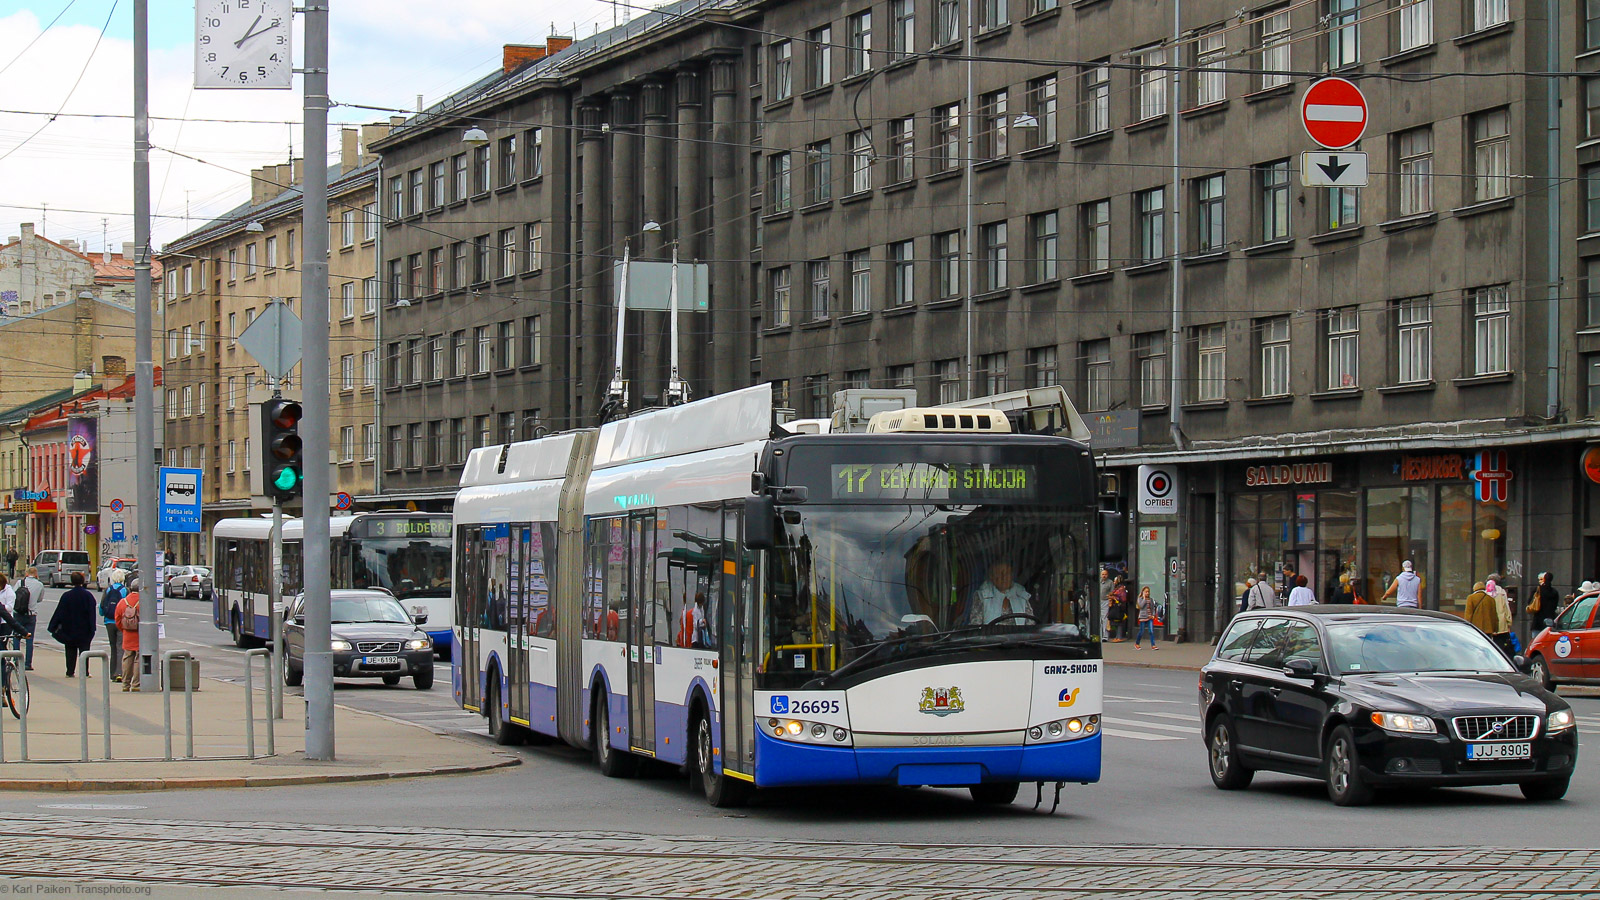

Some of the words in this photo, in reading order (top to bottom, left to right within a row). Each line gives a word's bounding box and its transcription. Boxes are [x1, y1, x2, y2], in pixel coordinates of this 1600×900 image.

[223, 4, 229, 13] 11
[238, 0, 249, 8] 12
[261, 4, 264, 13] 1
[208, 18, 220, 27] 10
[271, 18, 279, 27] 2
[202, 36, 210, 44] 9
[276, 36, 283, 44] 3
[207, 52, 216, 61] 8
[269, 54, 278, 62] 4
[221, 66, 229, 75] 7
[257, 66, 265, 75] 5
[239, 72, 247, 80] 6
[1400, 454, 1463, 481] HESBURGER
[838, 463, 873, 493] 17
[963, 468, 1026, 489] STACIJA
[1246, 462, 1332, 486] SALDUMI
[1144, 499, 1174, 507] OPTIBET
[376, 521, 385, 535] 3
[791, 700, 840, 714] 26695
[912, 735, 965, 746] SOLARIS
[1476, 744, 1529, 757] JJ-8905
